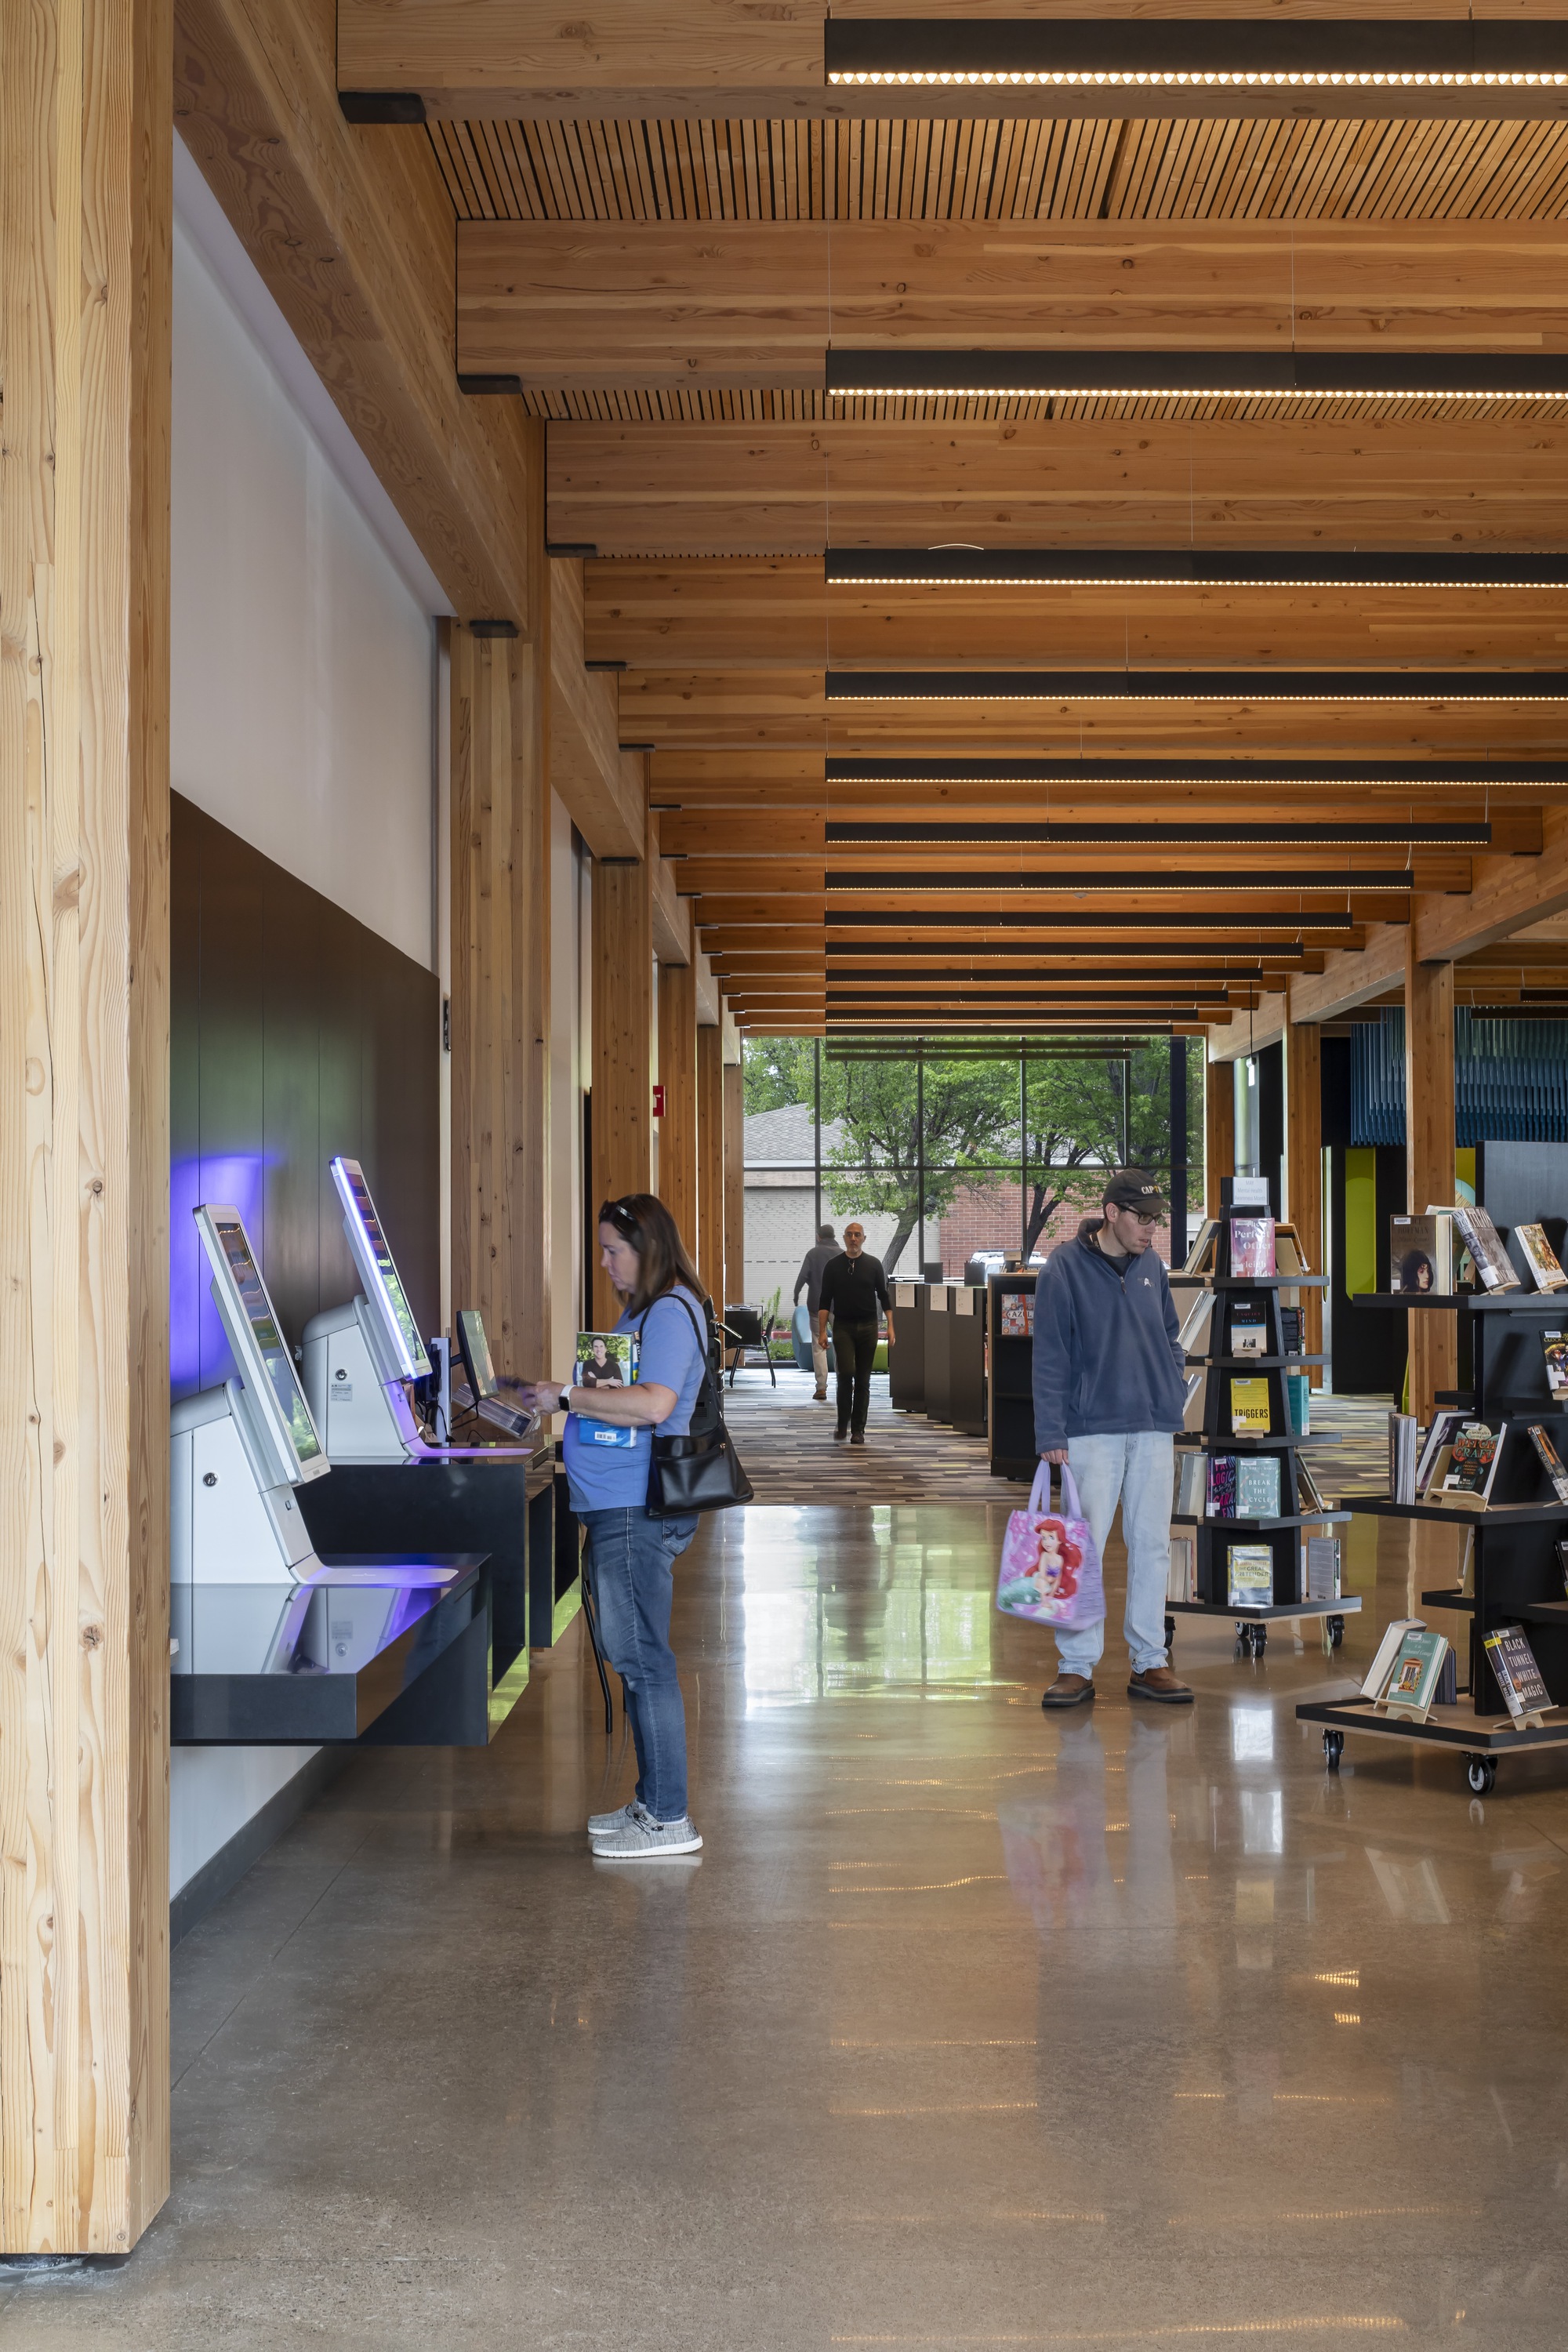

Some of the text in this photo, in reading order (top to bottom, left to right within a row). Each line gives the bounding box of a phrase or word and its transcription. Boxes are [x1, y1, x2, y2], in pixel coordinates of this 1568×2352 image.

[1243, 1241, 1272, 1250] Other
[1457, 1438, 1496, 1449] WITCH
[1455, 1447, 1495, 1458] CRAFT
[1504, 1638, 1525, 1652] BLACK
[1508, 1653, 1533, 1667] TUNNEL
[1497, 1671, 1506, 1687] WHITE
[1515, 1668, 1537, 1682] WHITE
[1523, 1684, 1543, 1699] MAGIC
